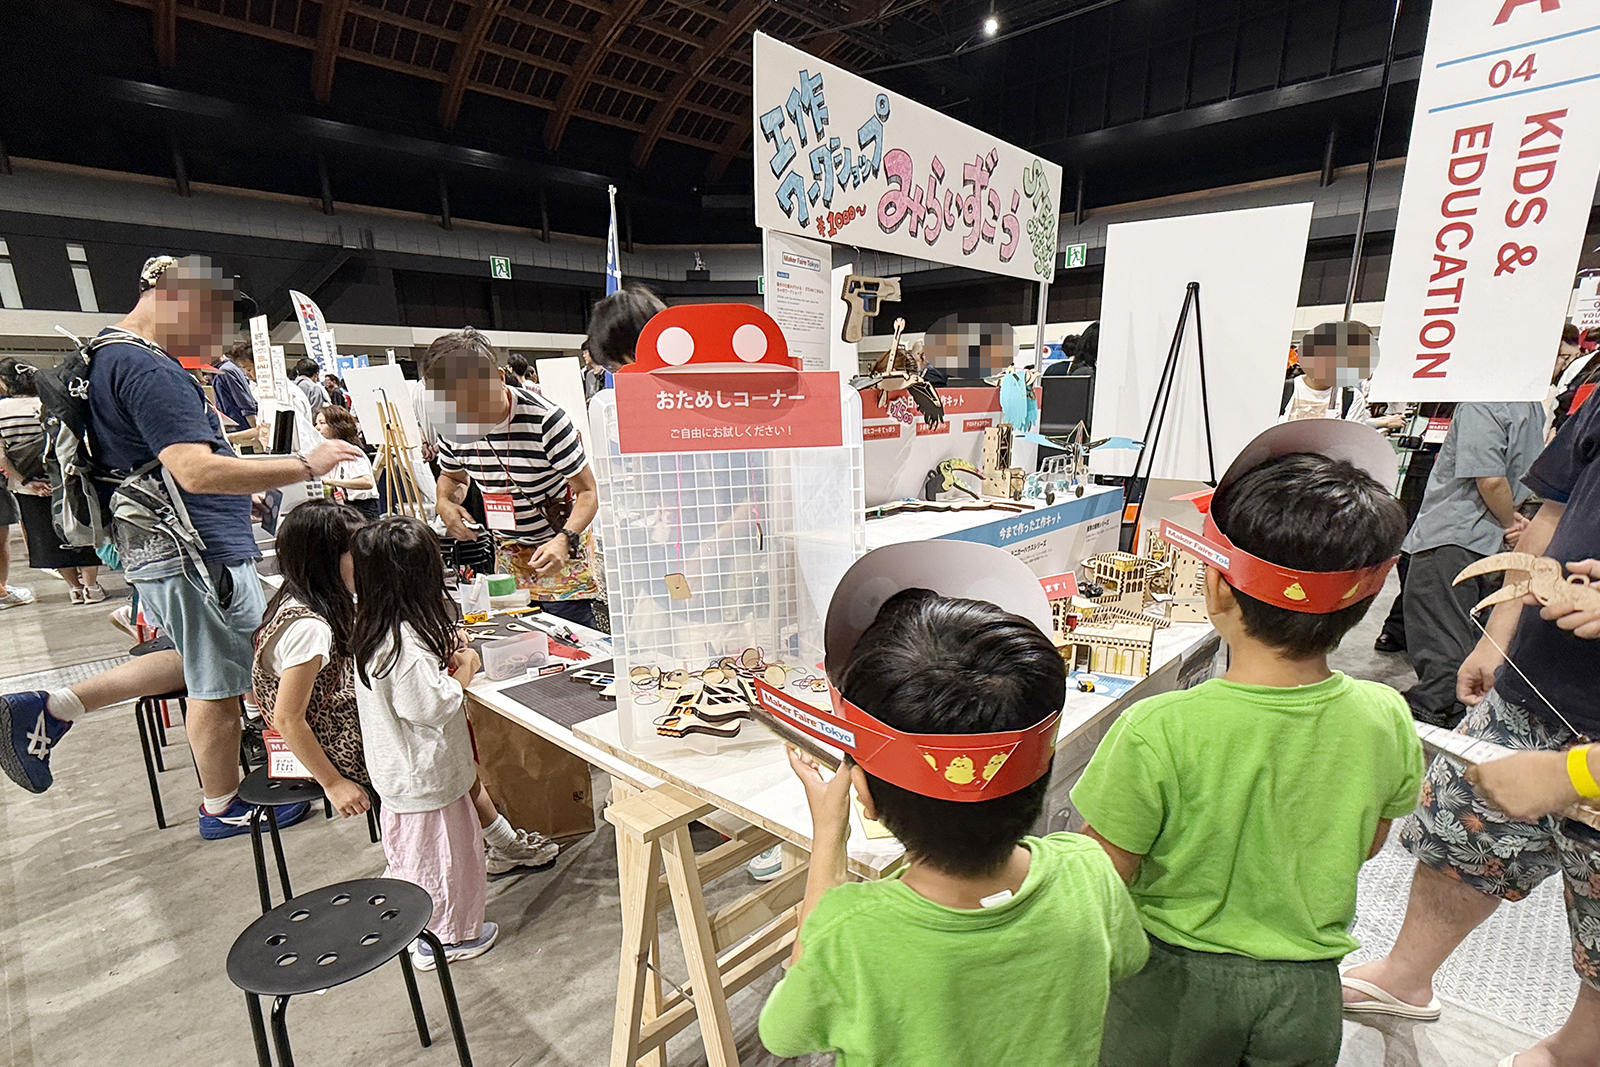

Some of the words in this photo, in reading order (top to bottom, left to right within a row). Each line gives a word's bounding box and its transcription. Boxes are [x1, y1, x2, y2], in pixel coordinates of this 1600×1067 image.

[1488, 53, 1538, 90] 04
[759, 69, 829, 178] 工作
[1503, 107, 1569, 229] KIDS
[807, 260, 820, 269] Tokyo
[1412, 122, 1494, 379] EDUCATION
[1493, 241, 1538, 277] &
[655, 389, 806, 410] おためしコーナー
[669, 425, 793, 440] ご自由にお試しください！
[999, 512, 1062, 541] 今まで作った工作キット
[1167, 529, 1192, 546] Maker
[1193, 541, 1213, 557] Faire
[1215, 553, 1229, 566] Tok
[764, 693, 792, 714] Maker
[793, 709, 817, 727] Faire
[818, 722, 852, 743] Tokyo
